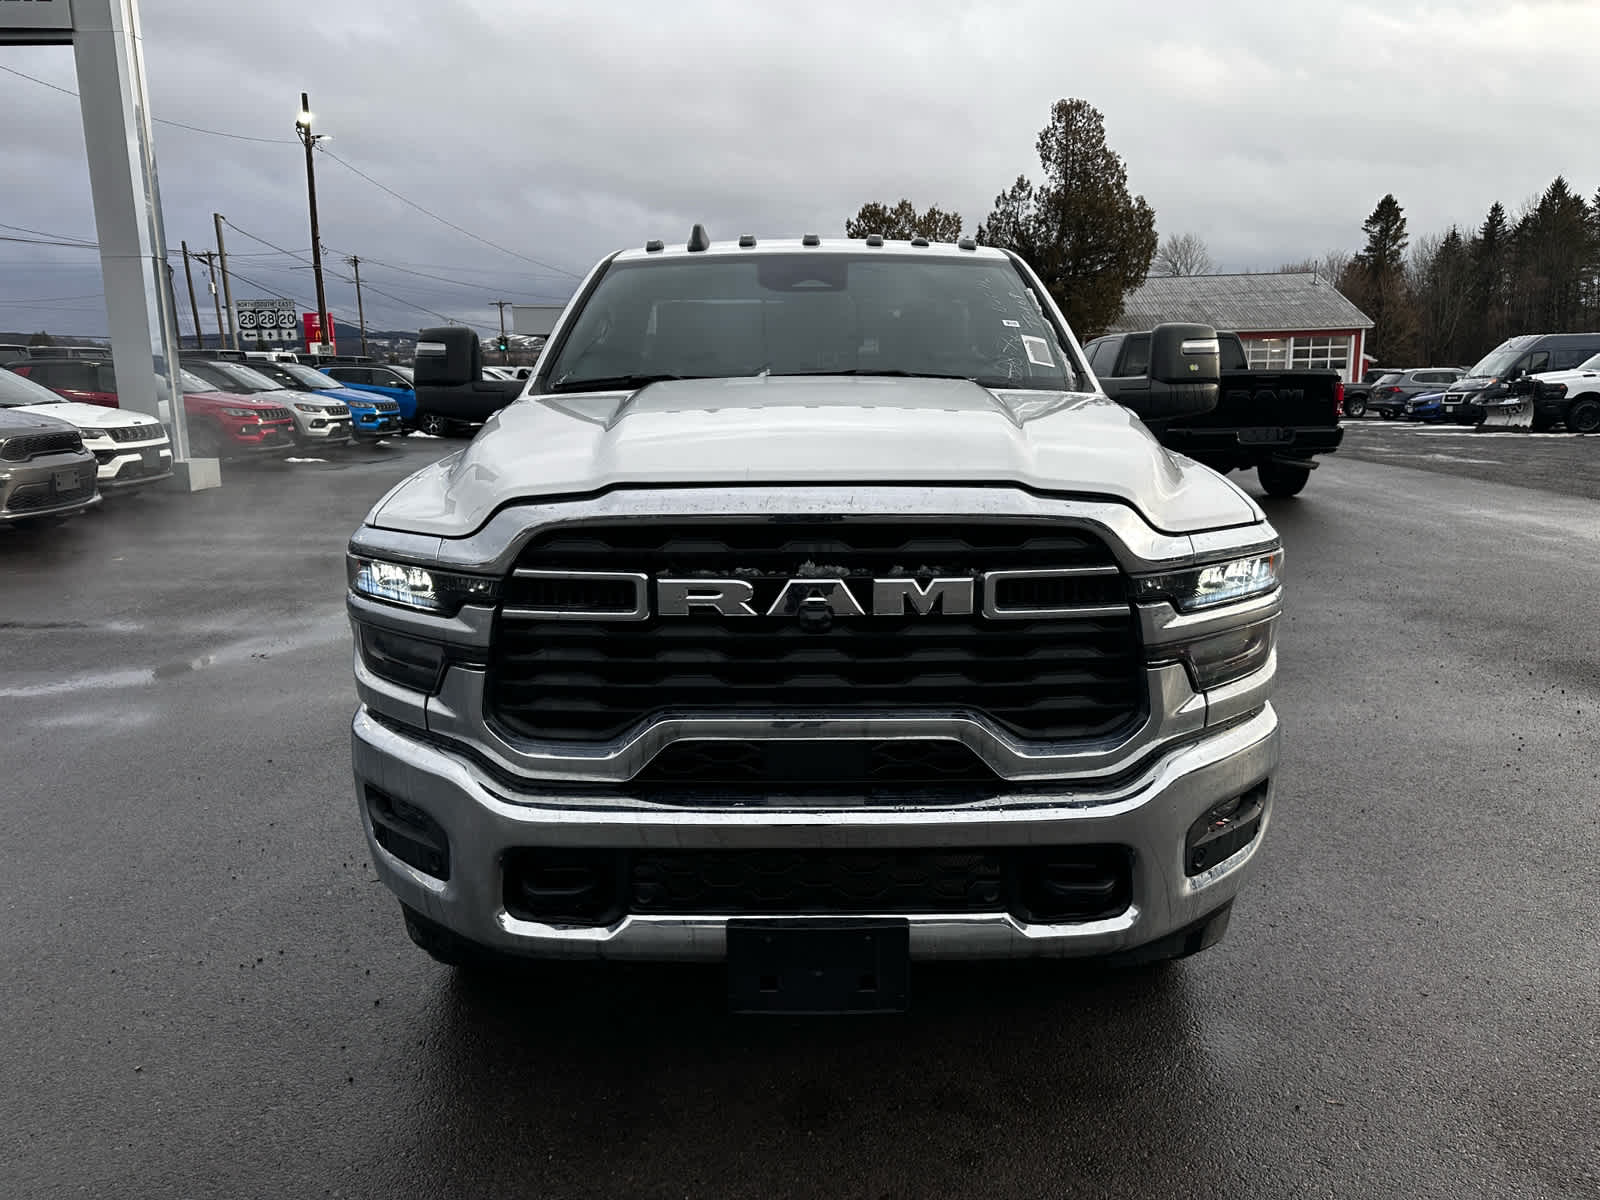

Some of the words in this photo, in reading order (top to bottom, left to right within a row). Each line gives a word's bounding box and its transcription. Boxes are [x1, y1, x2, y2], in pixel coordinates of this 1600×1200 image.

[240, 313, 255, 325] 28
[260, 313, 275, 325] 28
[279, 313, 295, 325] 20
[657, 577, 975, 616] RAM
